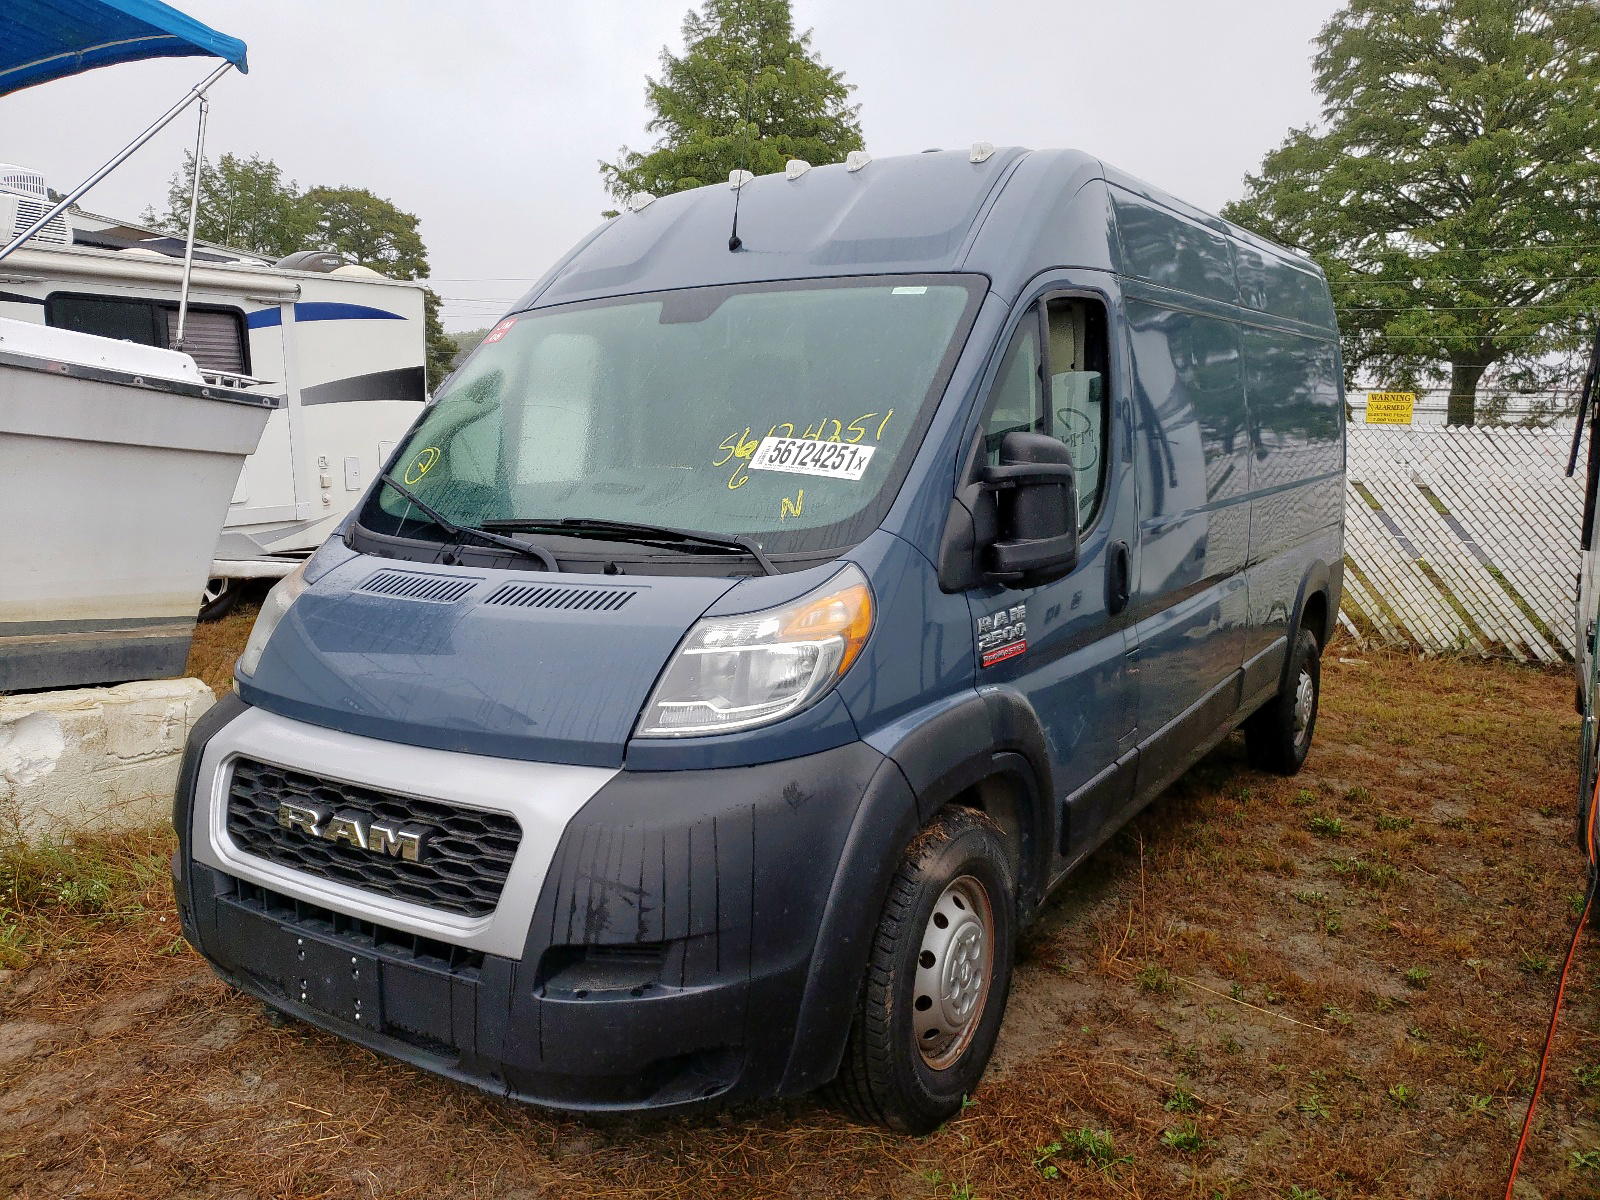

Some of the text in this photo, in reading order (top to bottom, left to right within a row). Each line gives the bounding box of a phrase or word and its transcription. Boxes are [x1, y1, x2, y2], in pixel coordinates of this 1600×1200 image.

[977, 604, 1026, 633] RAM
[978, 622, 1027, 652] 2500
[278, 799, 424, 863] RAM
